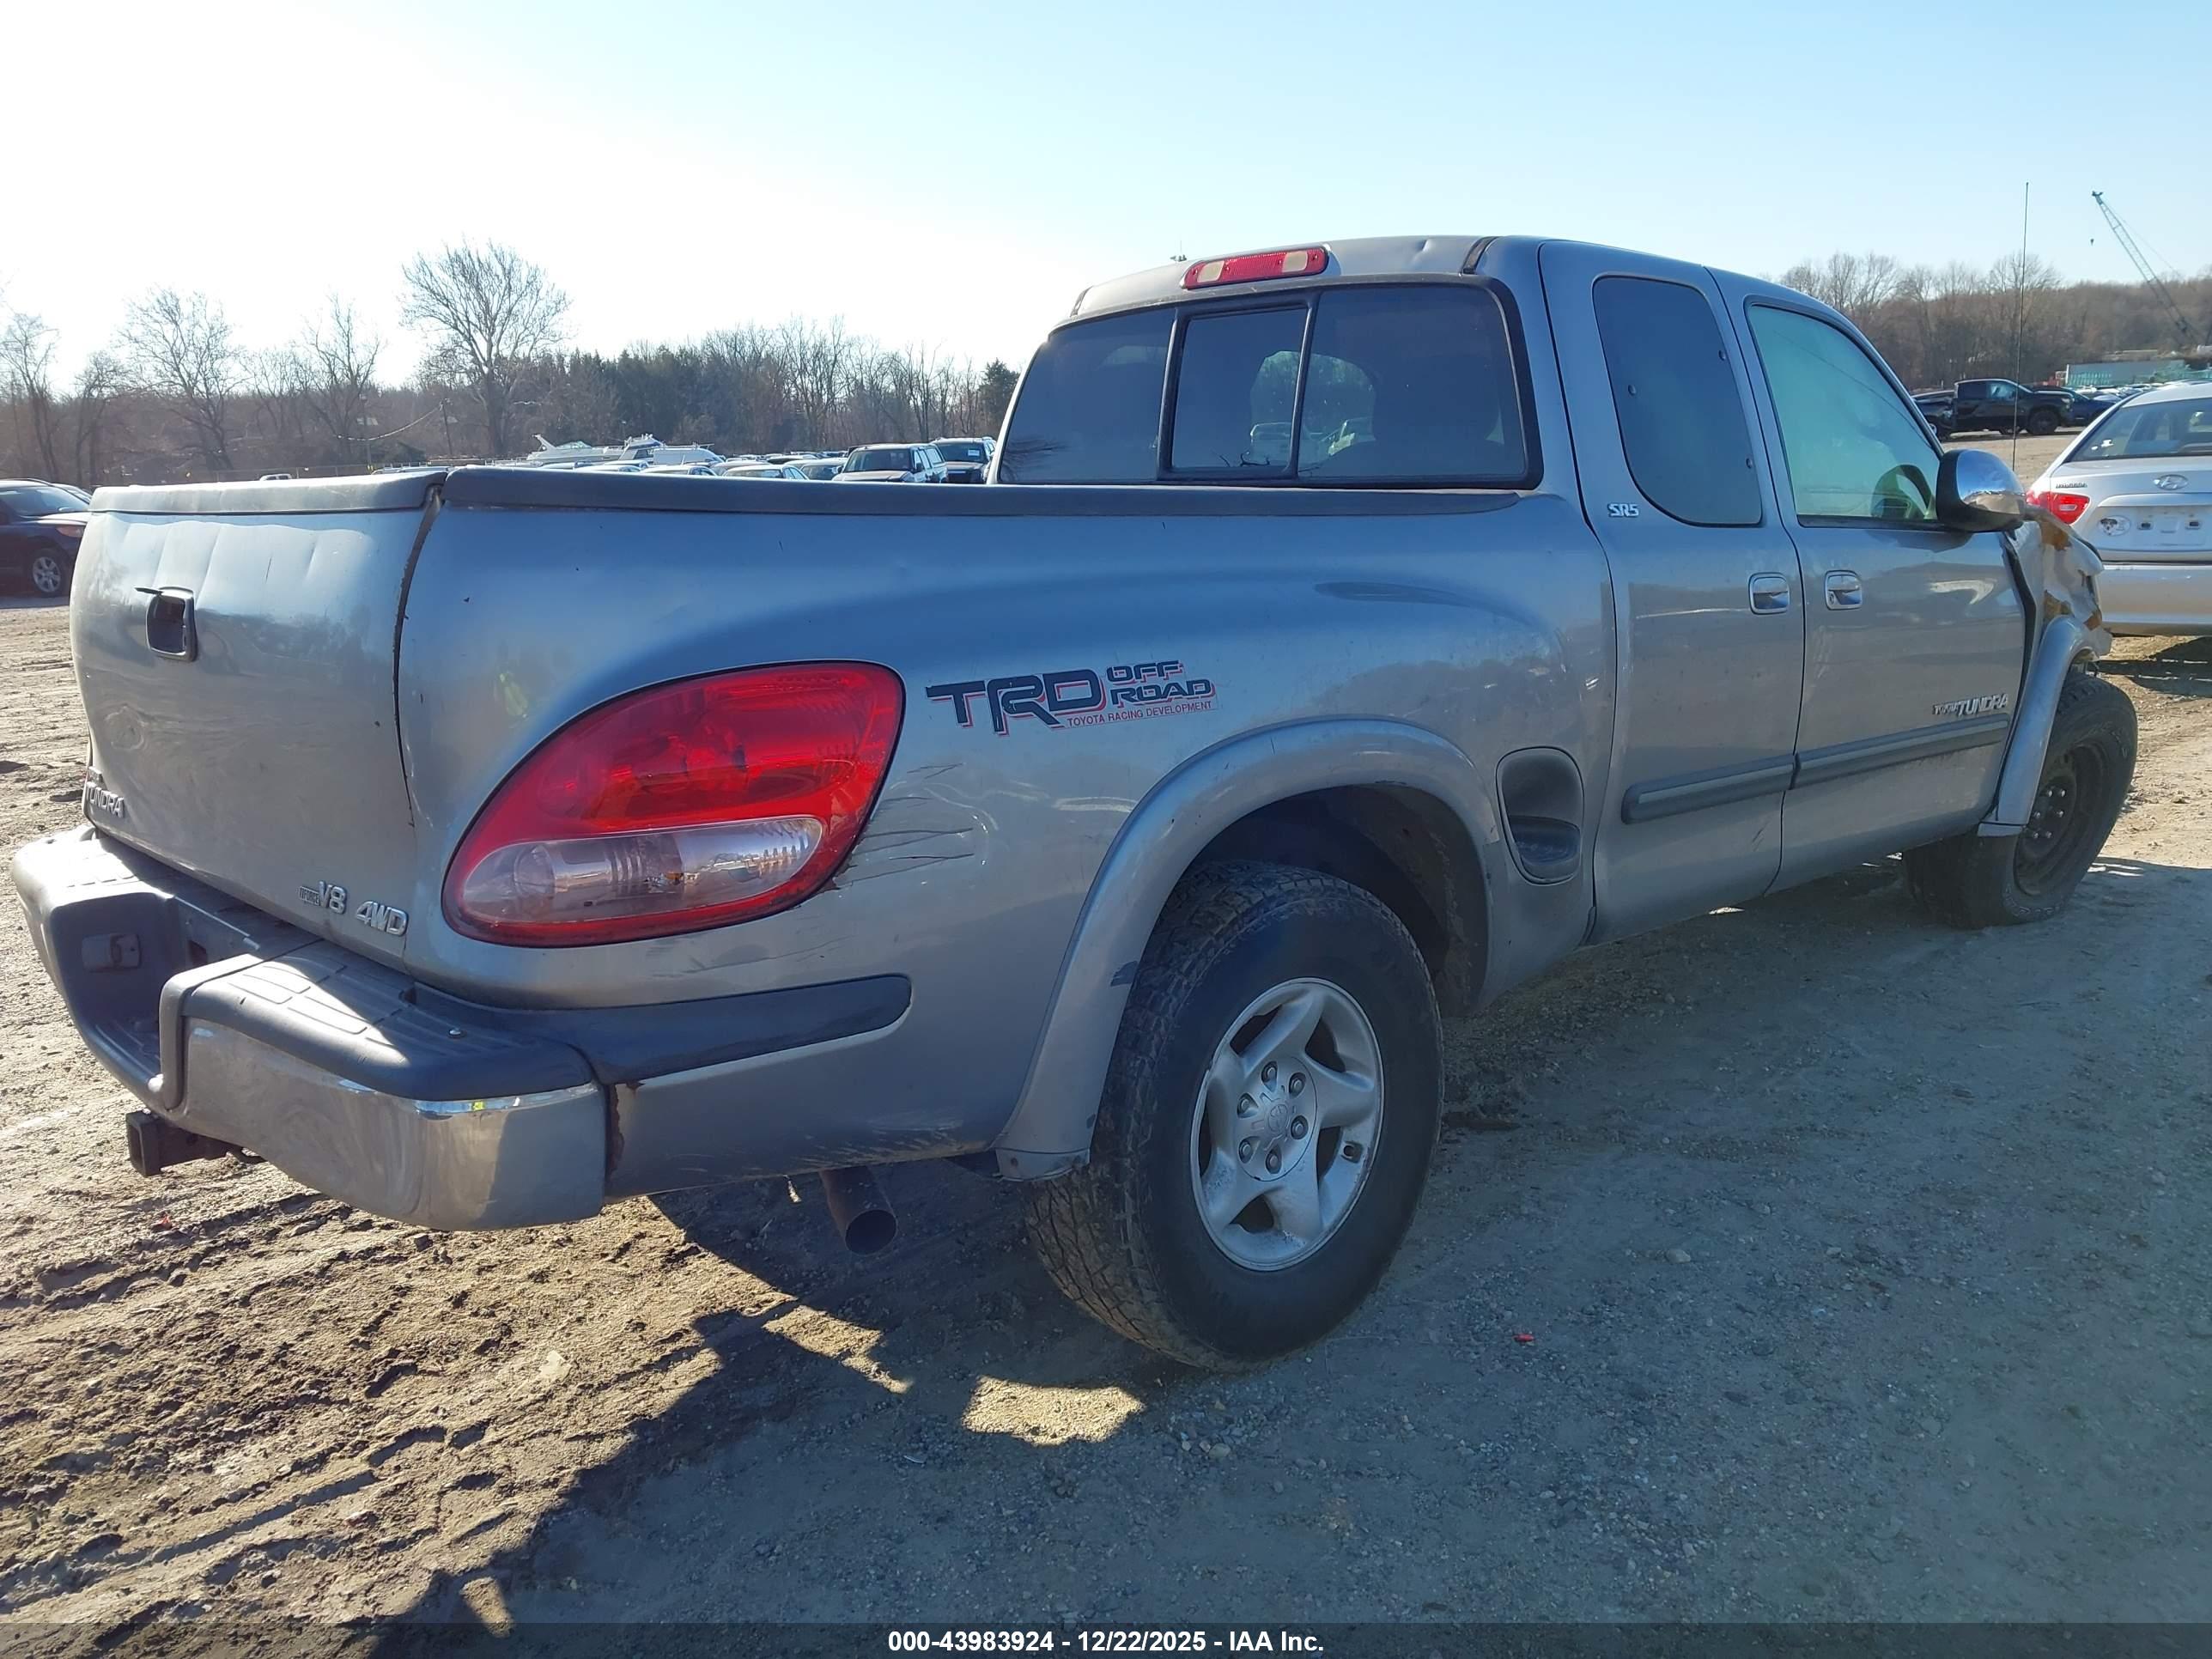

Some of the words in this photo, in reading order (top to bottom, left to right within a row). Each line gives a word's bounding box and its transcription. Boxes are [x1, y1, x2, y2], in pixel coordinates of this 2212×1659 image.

[1607, 502, 1639, 518] SR5
[1106, 659, 1184, 684] OFF
[925, 668, 1106, 736] TRD
[1110, 678, 1216, 708] ROAD
[1957, 693, 2008, 717] TUNDRA
[1067, 714, 1105, 727] TOYOTA
[1108, 709, 1144, 722] RACING
[1146, 701, 1212, 717] DEVELOPMENT
[86, 781, 125, 818] TUNDRA
[319, 880, 348, 915] V8
[356, 900, 409, 937] 4WD
